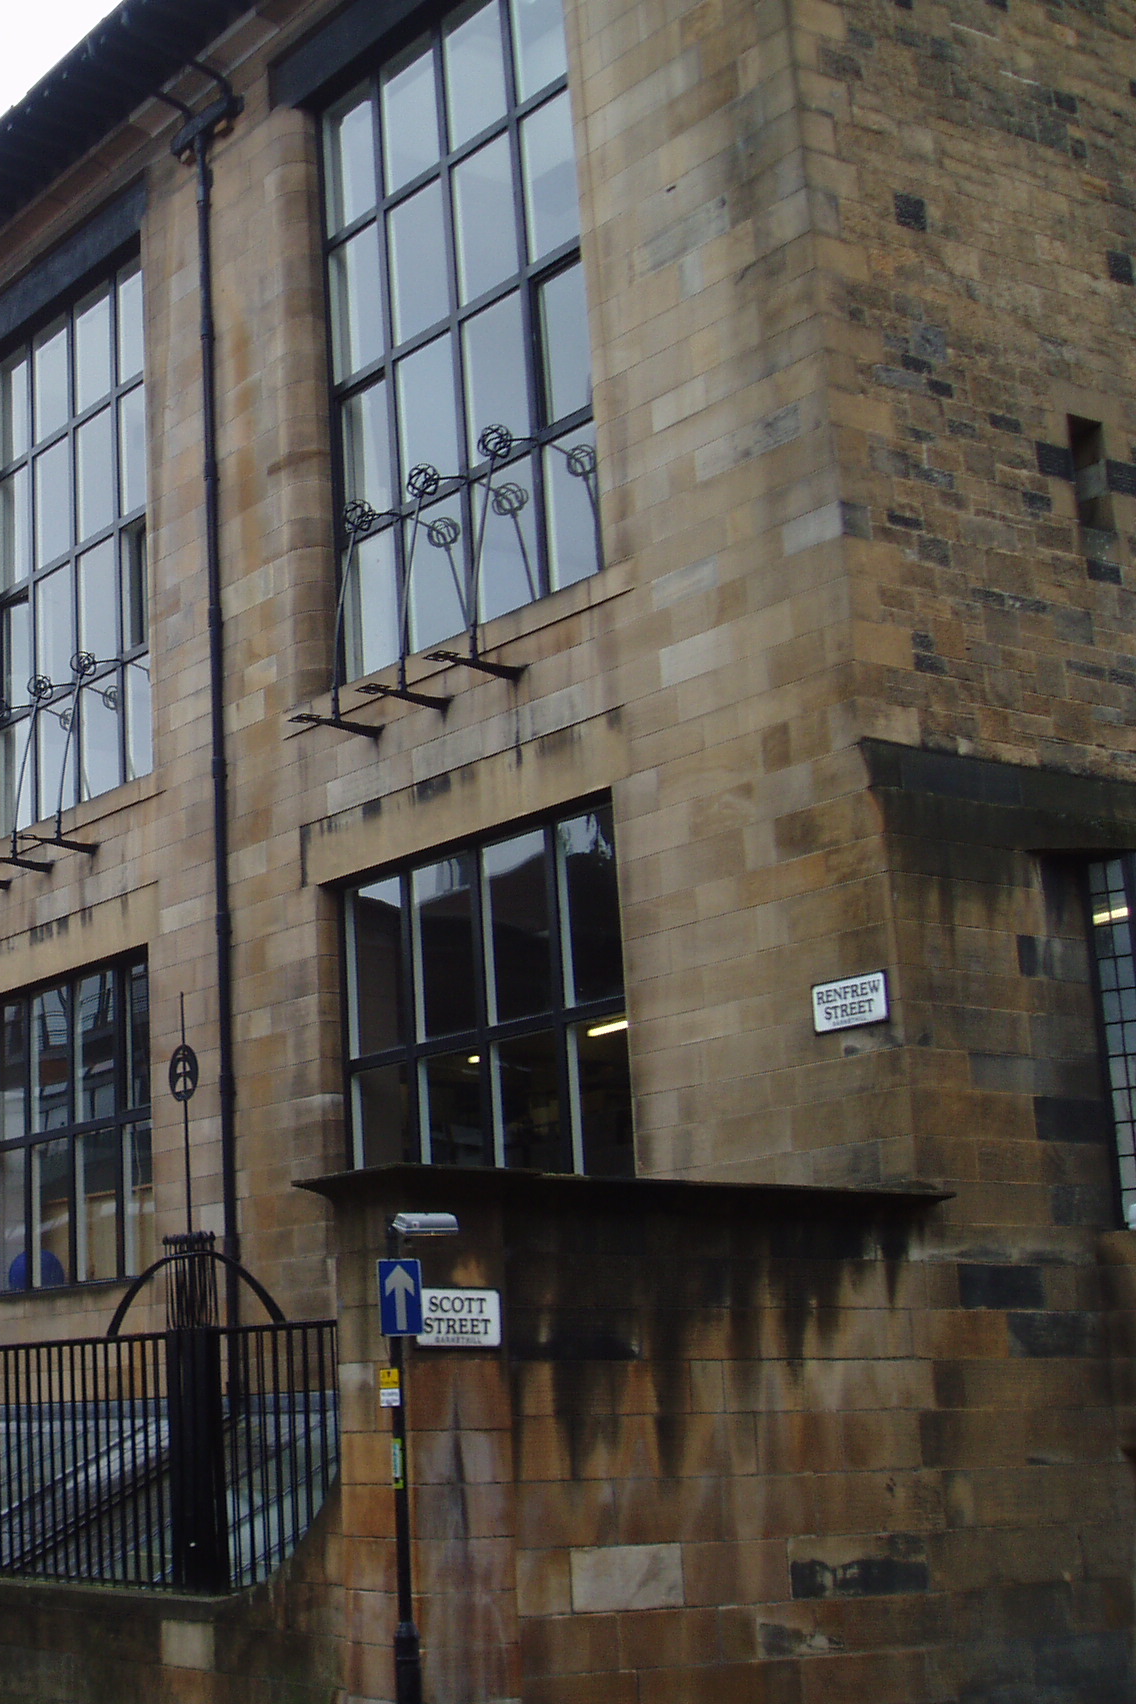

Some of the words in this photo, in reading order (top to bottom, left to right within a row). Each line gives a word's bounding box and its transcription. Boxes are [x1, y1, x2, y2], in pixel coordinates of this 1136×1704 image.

[816, 979, 881, 1005] RENFREW
[824, 999, 874, 1020] STREET
[429, 1296, 486, 1313] SCOTT
[424, 1317, 491, 1335] STREET
